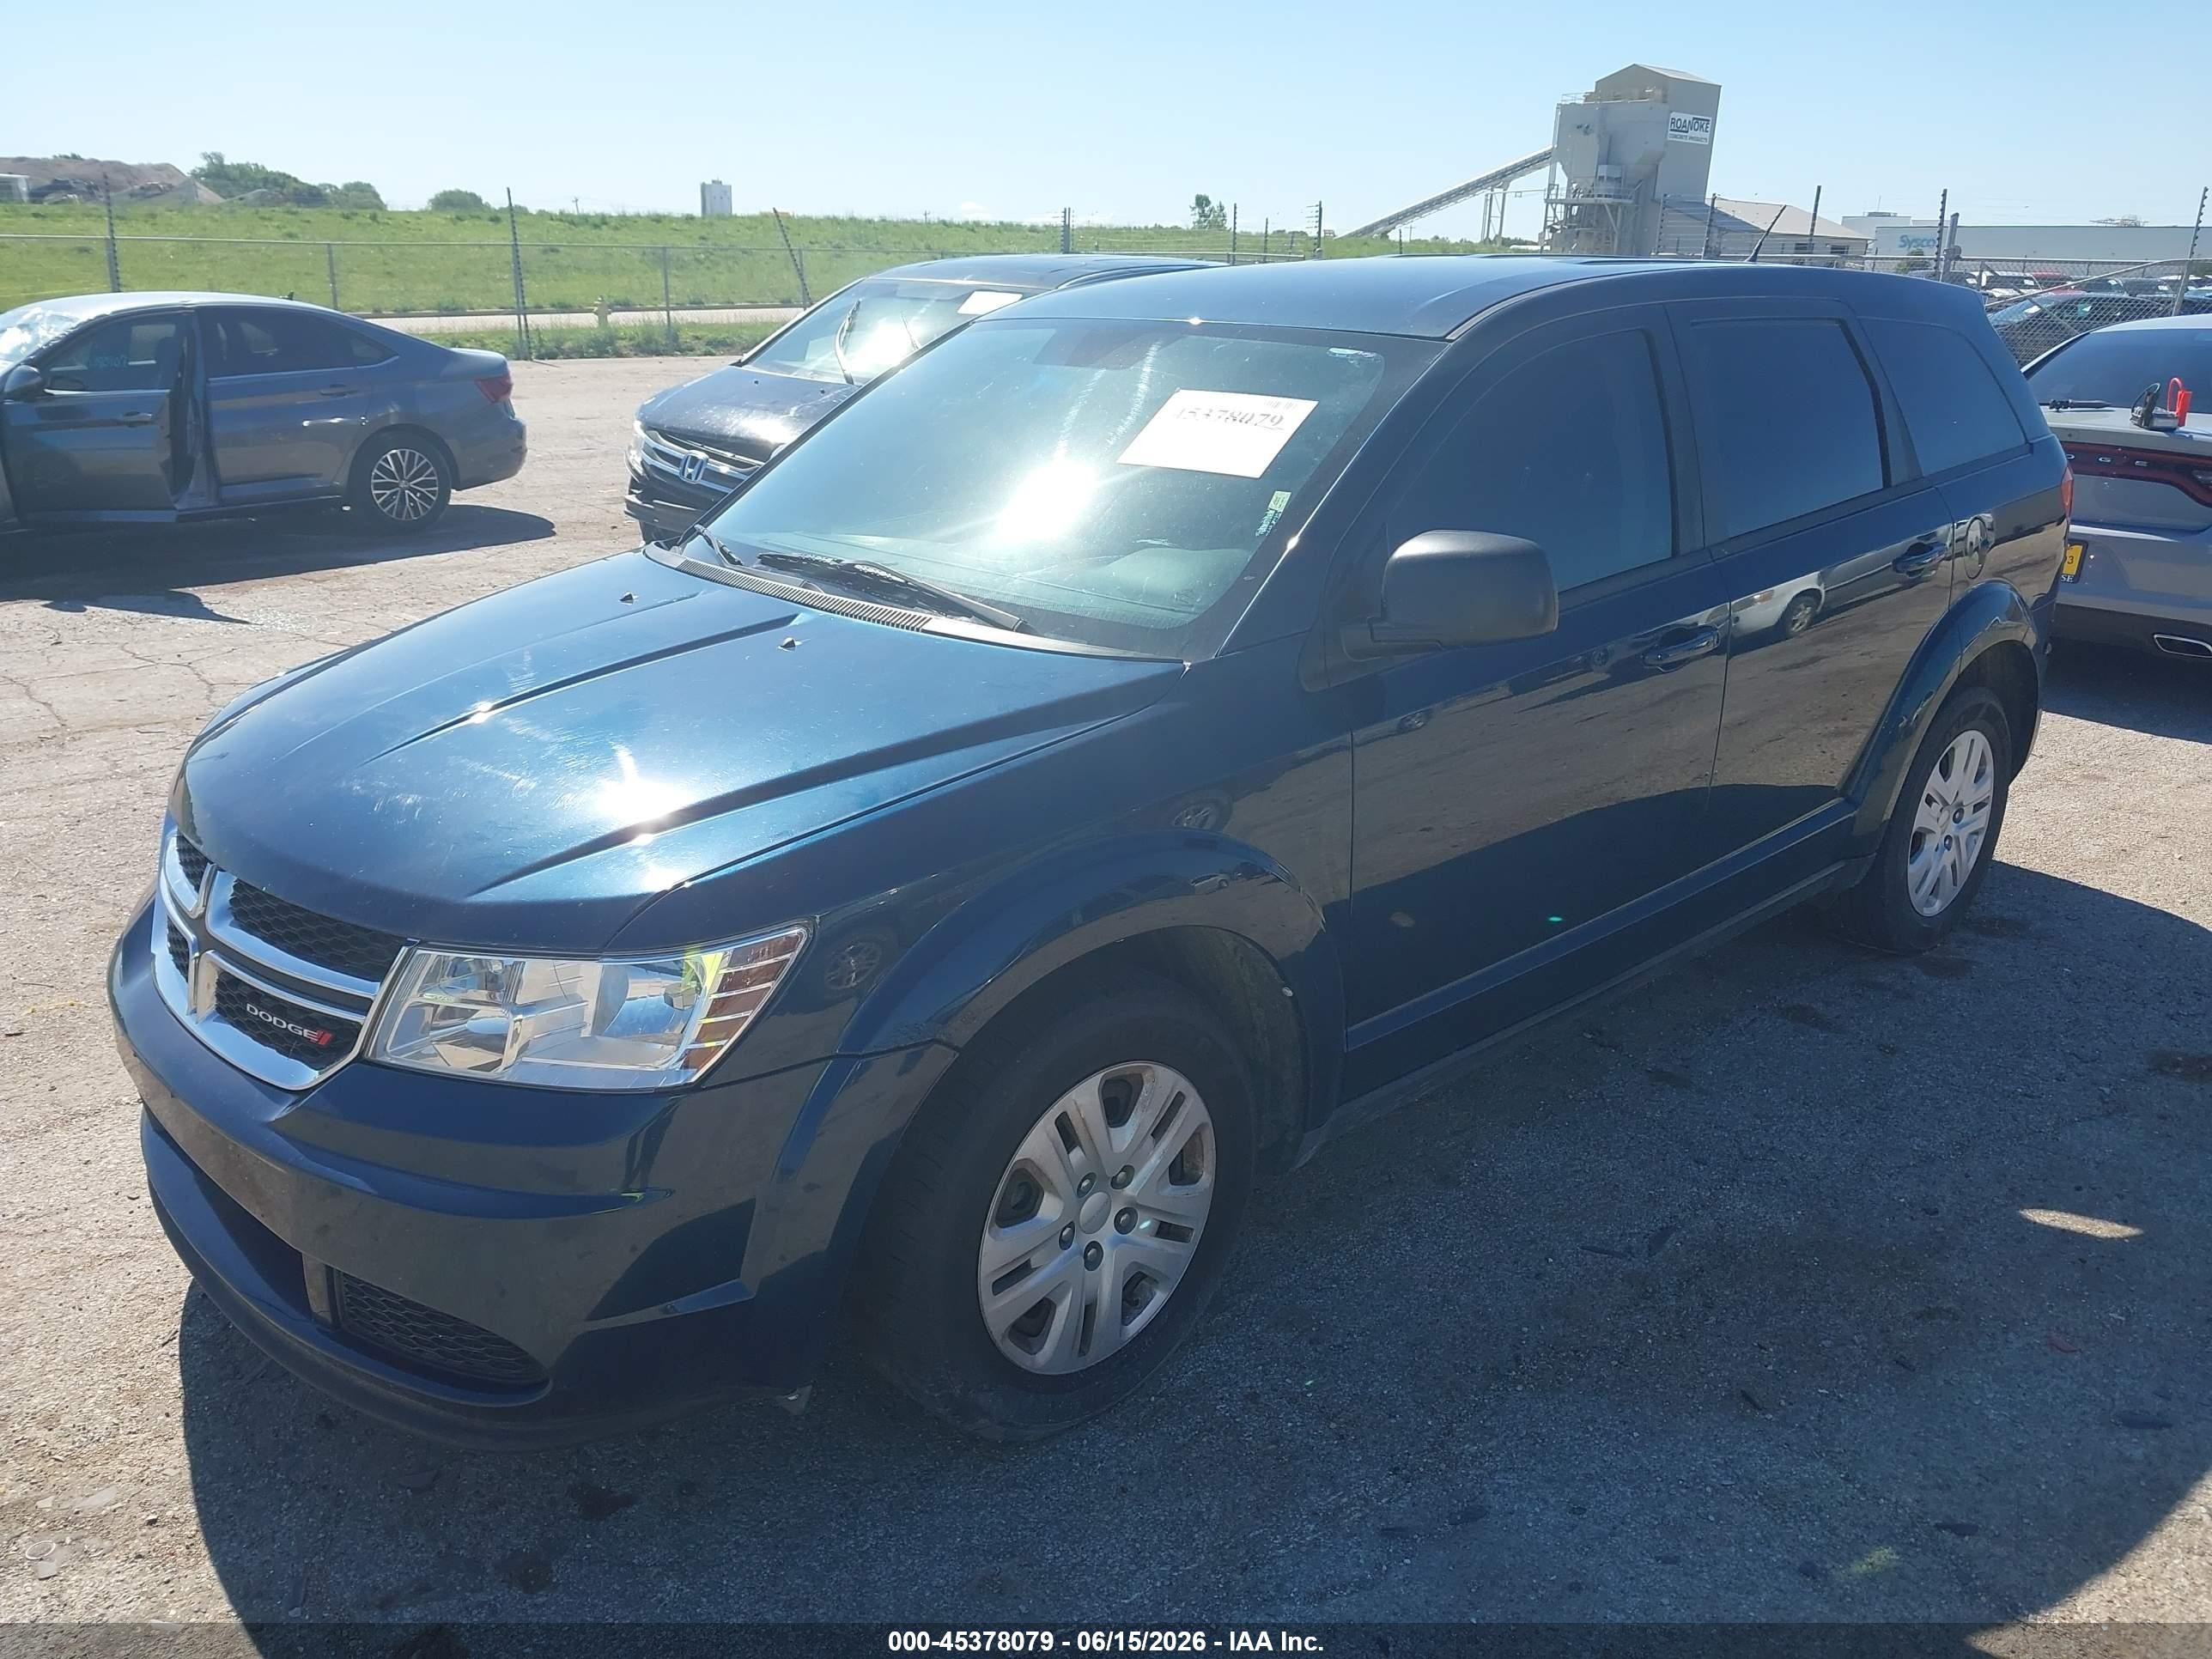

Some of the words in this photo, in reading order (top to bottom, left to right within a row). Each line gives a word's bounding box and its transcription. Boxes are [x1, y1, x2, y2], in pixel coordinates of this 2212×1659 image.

[1670, 117, 1710, 133] ROANOKE
[1898, 234, 1937, 250] Sysco
[246, 1003, 319, 1042] DODGE
